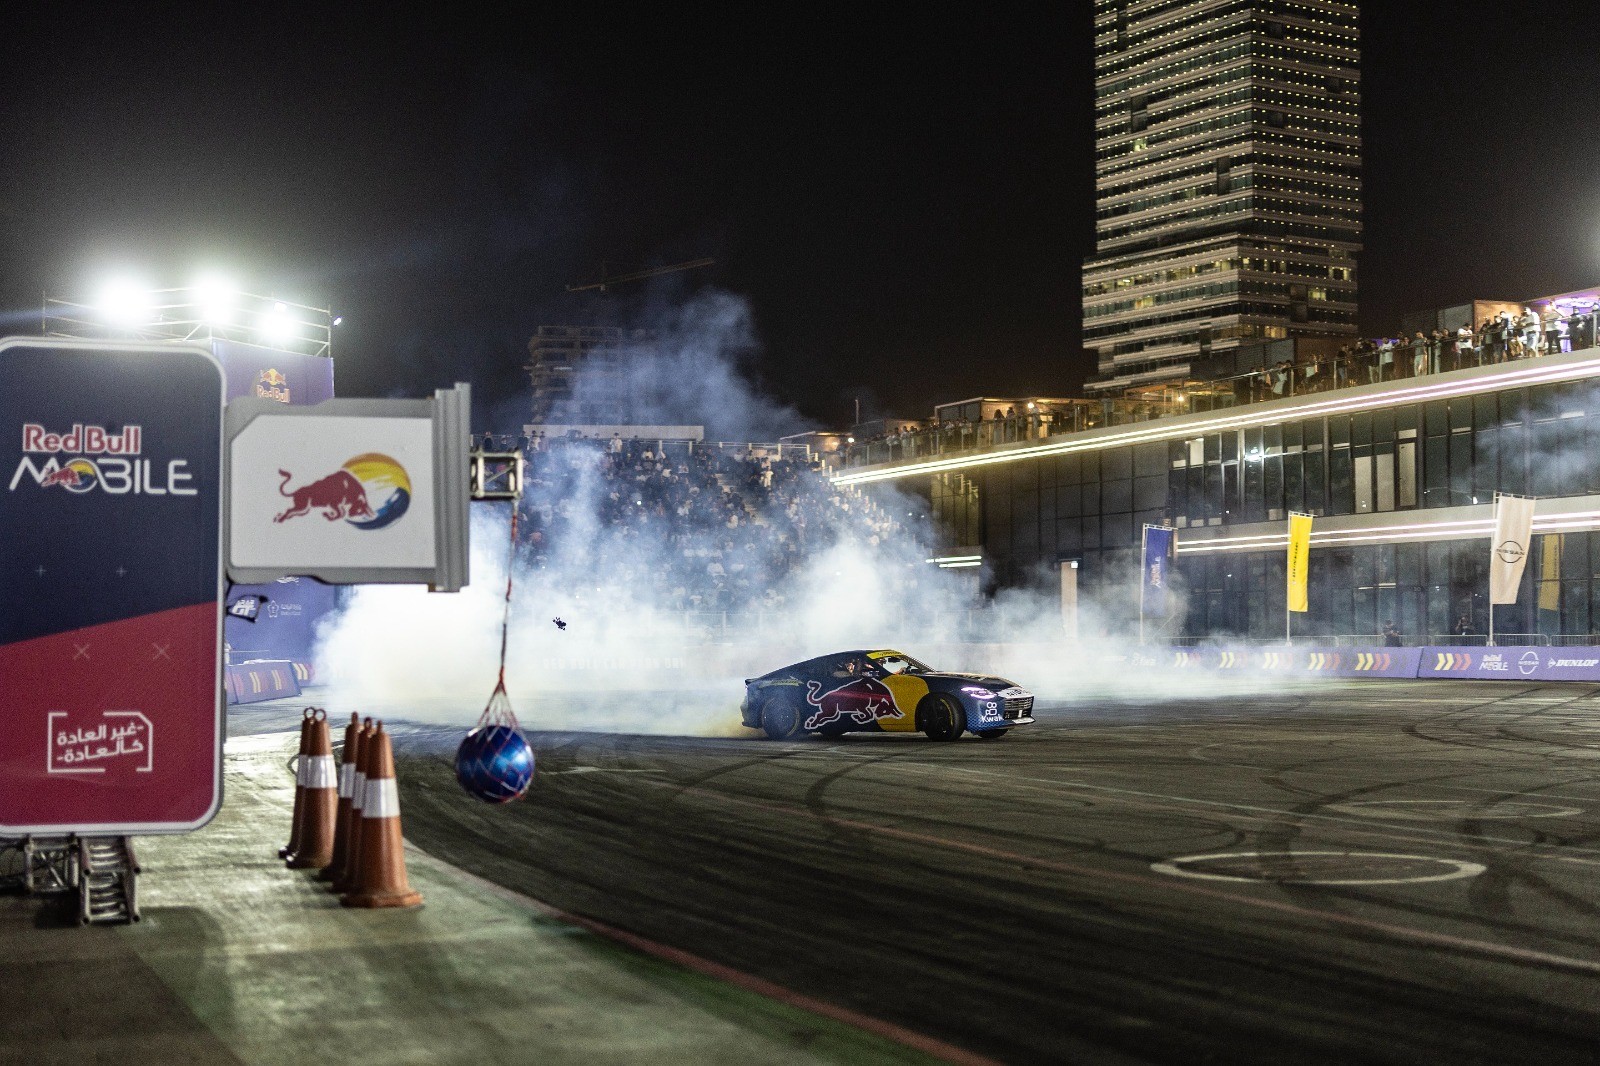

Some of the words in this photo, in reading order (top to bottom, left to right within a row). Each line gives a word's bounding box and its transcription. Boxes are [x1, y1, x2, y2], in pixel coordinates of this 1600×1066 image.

[23, 424, 83, 453] Red
[84, 426, 142, 454] Bull
[9, 456, 198, 495] MOBILE
[1555, 659, 1600, 667] DUNLOP
[57, 724, 107, 746] العادة
